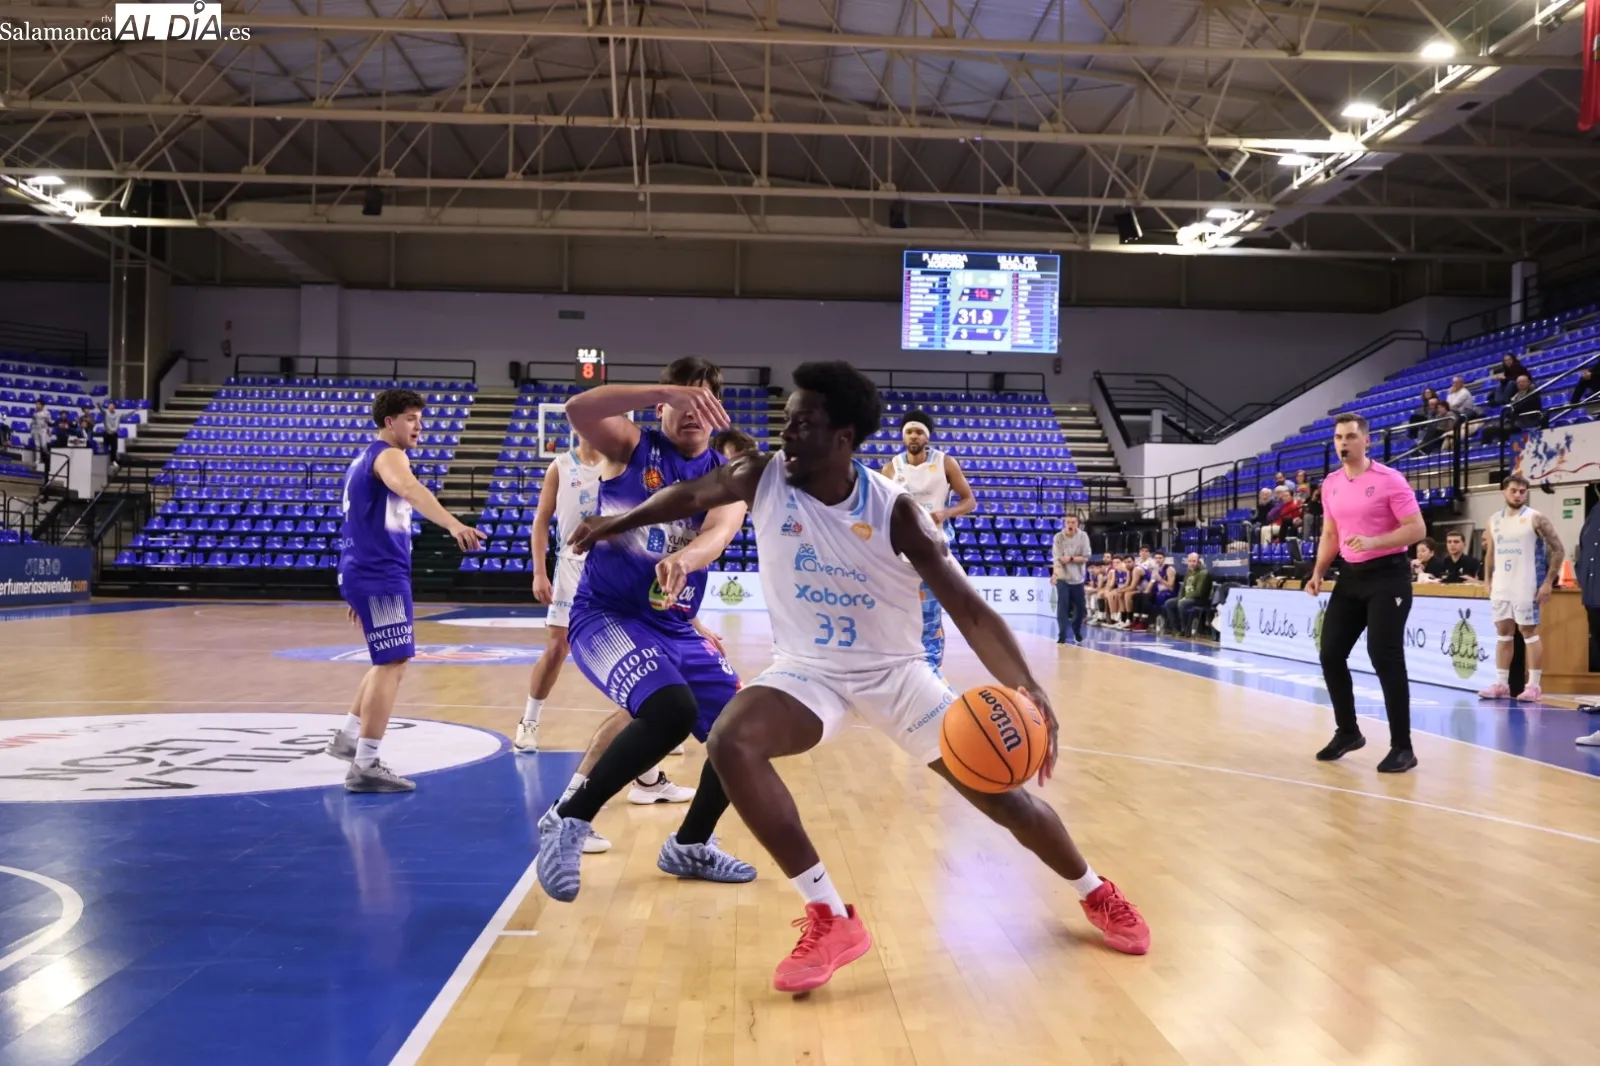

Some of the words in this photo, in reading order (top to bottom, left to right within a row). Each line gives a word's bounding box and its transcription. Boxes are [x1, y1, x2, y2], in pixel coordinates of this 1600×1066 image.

[958, 308, 993, 325] 31.9
[960, 328, 968, 339] 3
[583, 363, 594, 379] 8
[668, 534, 692, 546] XUNT
[1504, 560, 1512, 572] 6
[795, 583, 876, 609] Xoborg
[982, 589, 1002, 602] TE
[1009, 589, 1019, 602] &
[814, 612, 857, 647] 33
[1259, 607, 1298, 639] lolito
[1440, 630, 1490, 662] lolito
[977, 689, 1022, 753] Wilson
[82, 721, 418, 792] CSTILLA
